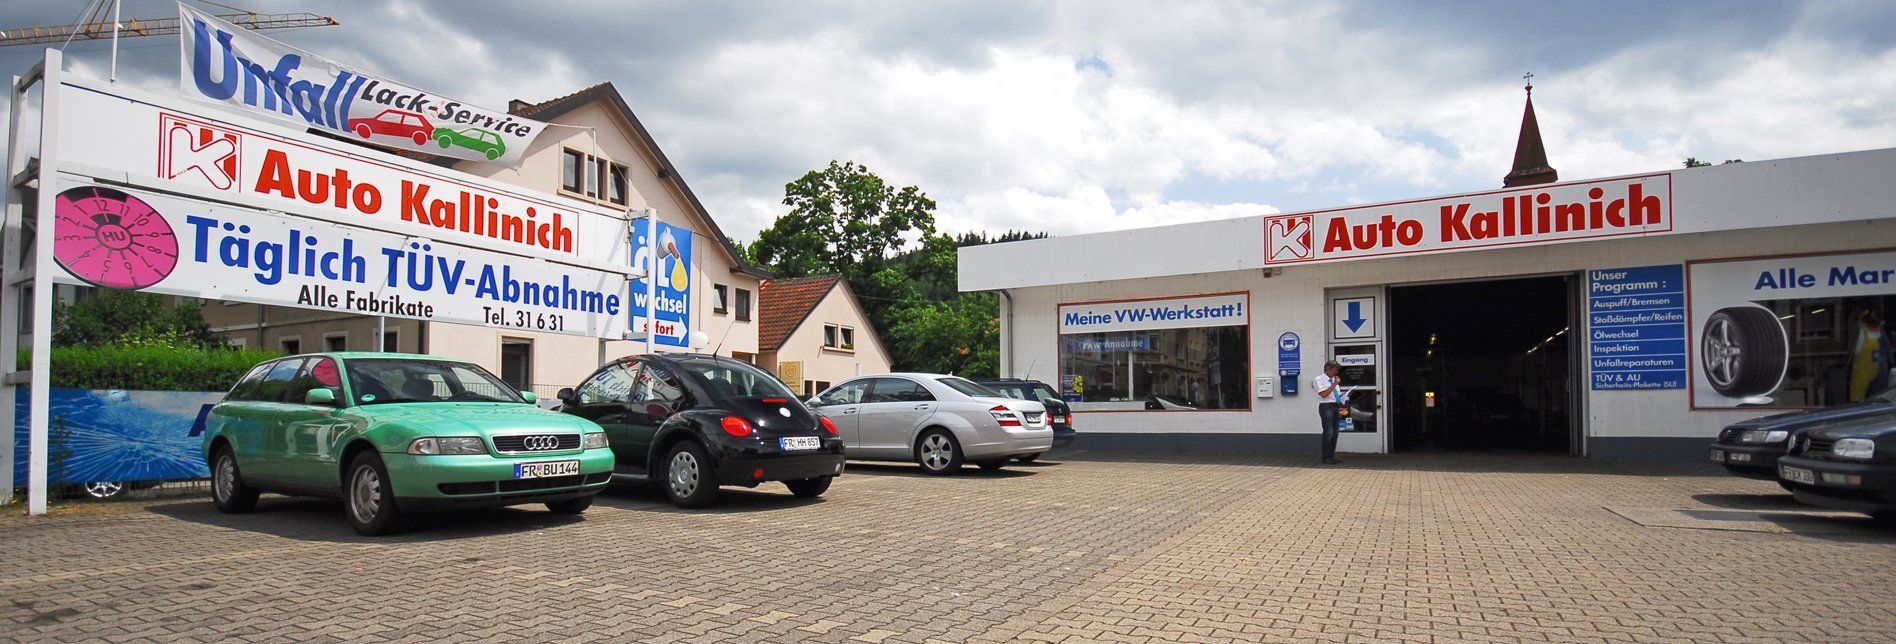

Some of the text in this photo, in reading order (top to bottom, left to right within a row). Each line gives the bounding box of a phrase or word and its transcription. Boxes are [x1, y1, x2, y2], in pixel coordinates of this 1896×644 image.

[194, 18, 366, 132] Unfall
[361, 80, 531, 138] Lack-Service
[254, 149, 572, 253] Auto Kallinich
[1322, 183, 1661, 253] Auto Kallinich
[102, 231, 125, 241] HU
[186, 215, 620, 316] Täglich TÜV-Abnahme
[1593, 271, 1627, 281] Unser
[1754, 266, 1895, 290] Alle Mar
[1593, 281, 1658, 293] Programm
[297, 285, 433, 318] Alle Fabrikate
[634, 290, 687, 315] wchsel
[1594, 298, 1670, 309] Auspuff/Bremsen
[483, 306, 510, 326] Tel.
[1065, 302, 1242, 326] Meine VW-Werkstatt!
[1594, 313, 1683, 324] Stoßdämpfer/Reifen
[643, 321, 674, 335] sfort
[1594, 329, 1639, 339] Ölwechsel
[1594, 344, 1639, 353] Inspektion
[1594, 358, 1674, 368] Unfallreparaturen
[1596, 373, 1614, 382] TÜV
[1627, 374, 1641, 382] AU
[521, 464, 537, 477] FR
